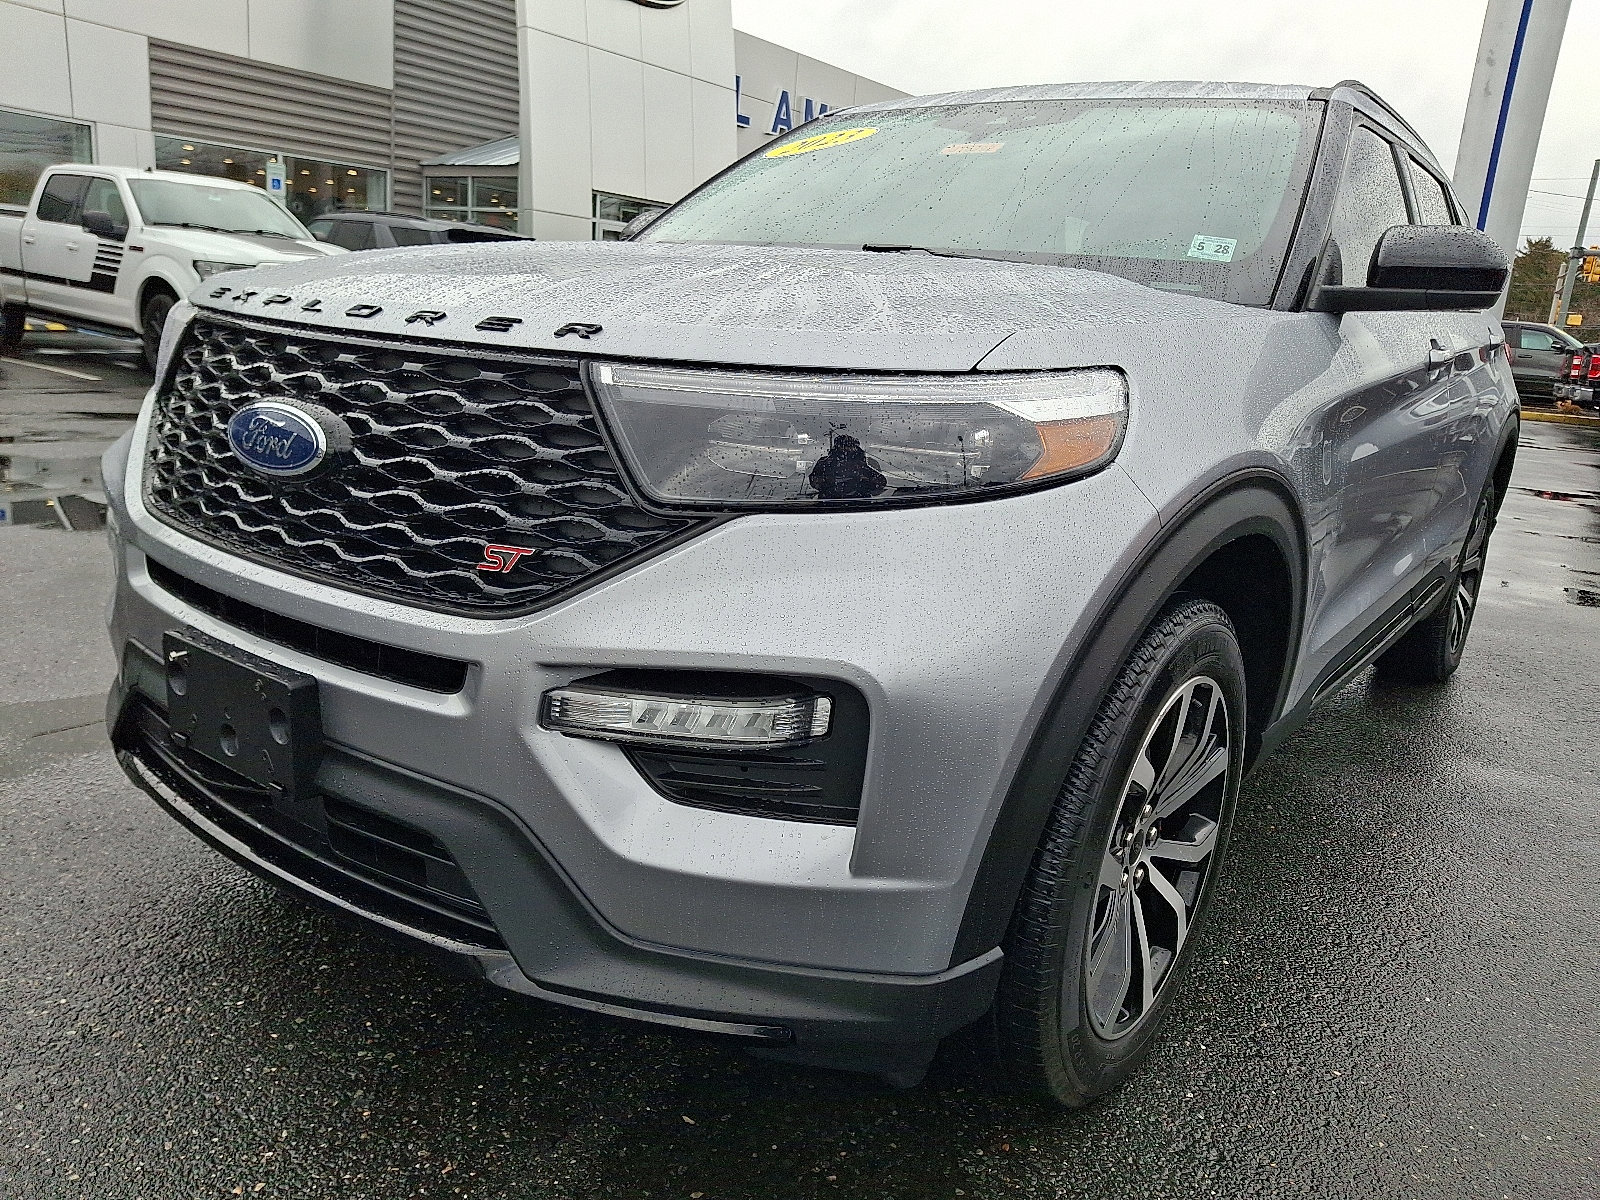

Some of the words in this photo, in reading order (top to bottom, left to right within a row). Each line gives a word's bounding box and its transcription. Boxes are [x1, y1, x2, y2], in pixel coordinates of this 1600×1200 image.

[1196, 241, 1205, 251] 5
[1213, 244, 1230, 255] 28
[209, 287, 603, 340] EXPLORER
[242, 415, 298, 460] Ford
[476, 543, 535, 573] ST
